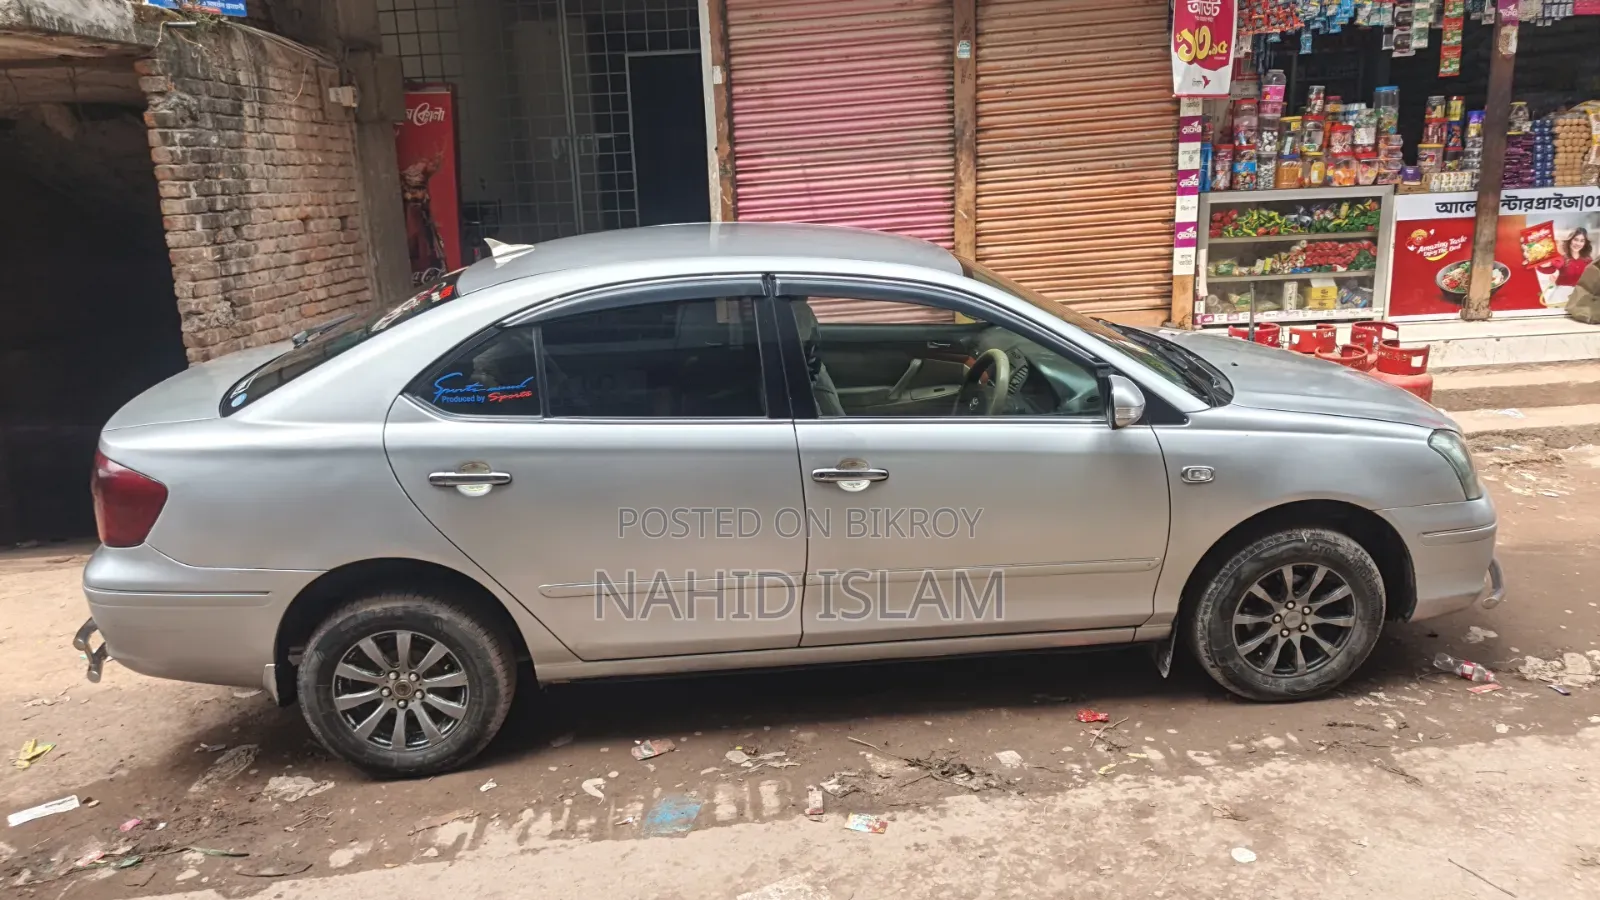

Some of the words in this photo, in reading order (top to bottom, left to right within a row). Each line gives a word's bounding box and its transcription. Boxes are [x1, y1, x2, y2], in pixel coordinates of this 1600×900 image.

[1416, 241, 1449, 254] Amazing
[442, 395, 475, 403] Produced
[476, 394, 485, 404] by
